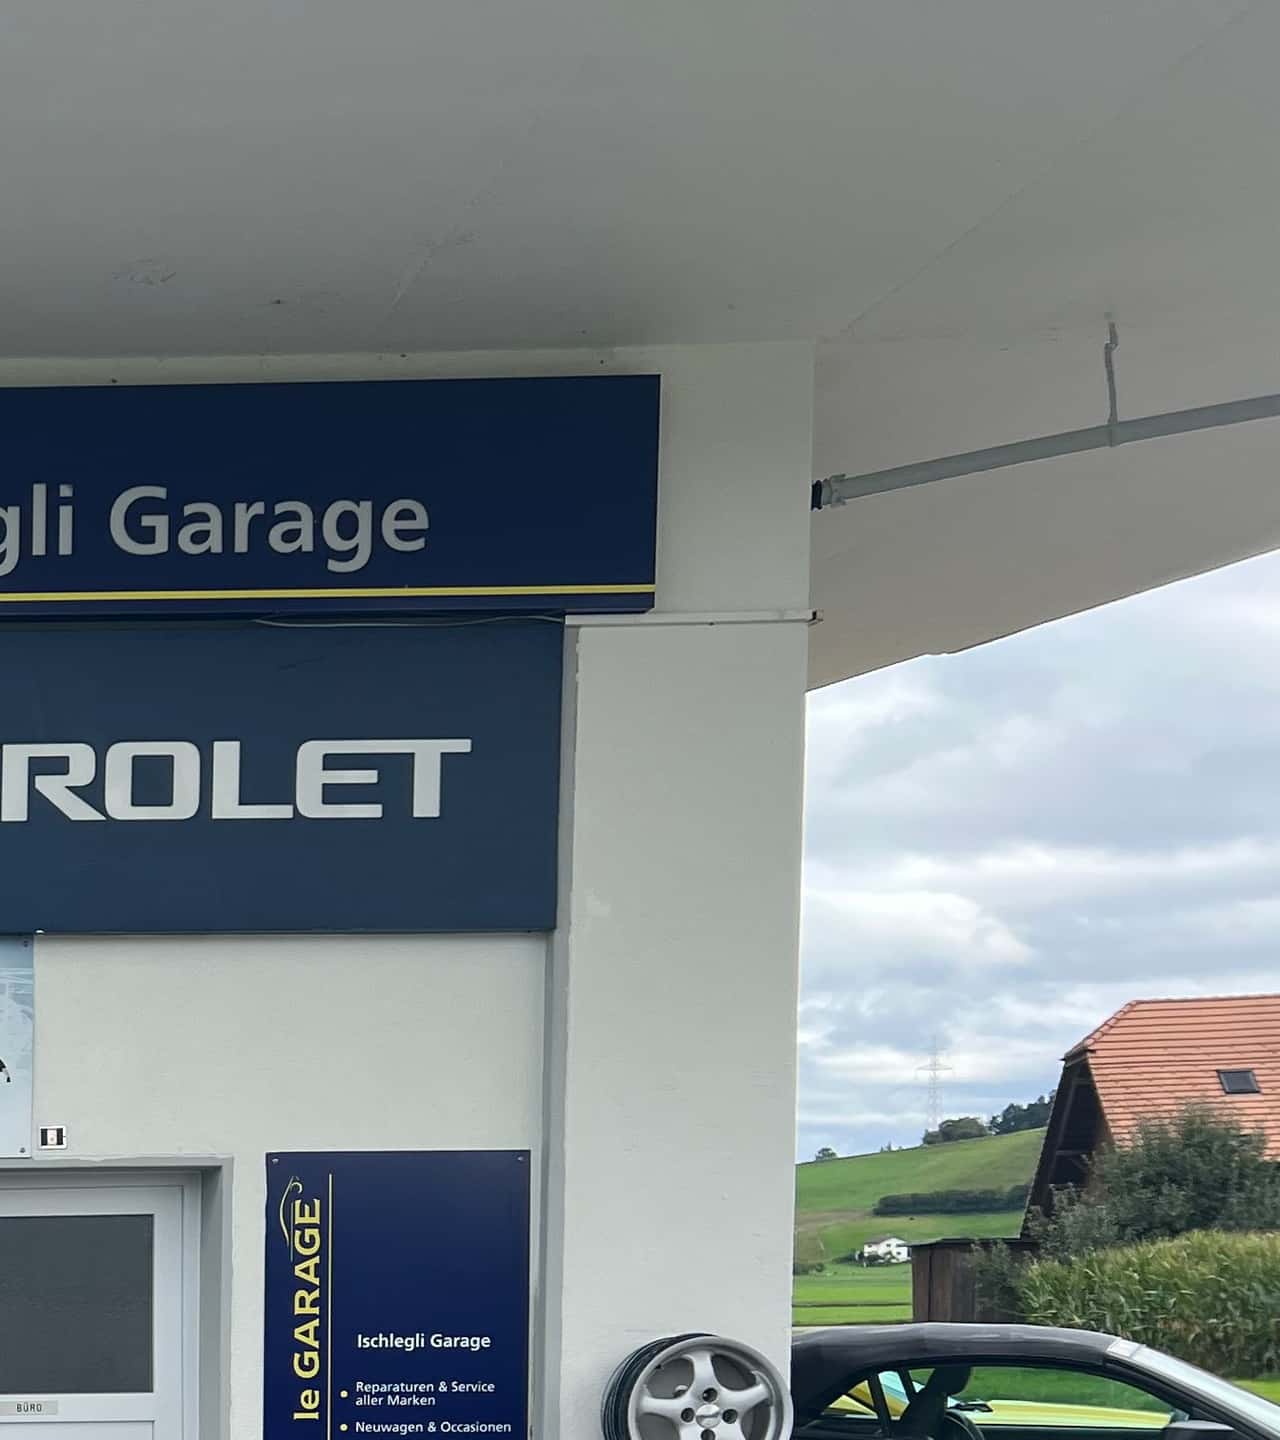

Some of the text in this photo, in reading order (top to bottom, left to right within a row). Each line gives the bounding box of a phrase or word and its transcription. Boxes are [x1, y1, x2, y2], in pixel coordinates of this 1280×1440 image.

[109, 484, 430, 573] Garage
[292, 1198, 321, 1420] le GARAGE
[357, 1333, 491, 1351] Ischlegli Garage
[356, 1381, 434, 1395] Reparaturen
[451, 1380, 495, 1393] Service
[355, 1394, 436, 1406] aller Marken
[355, 1421, 424, 1436] Neuwagen
[440, 1421, 512, 1433] Occasionen
